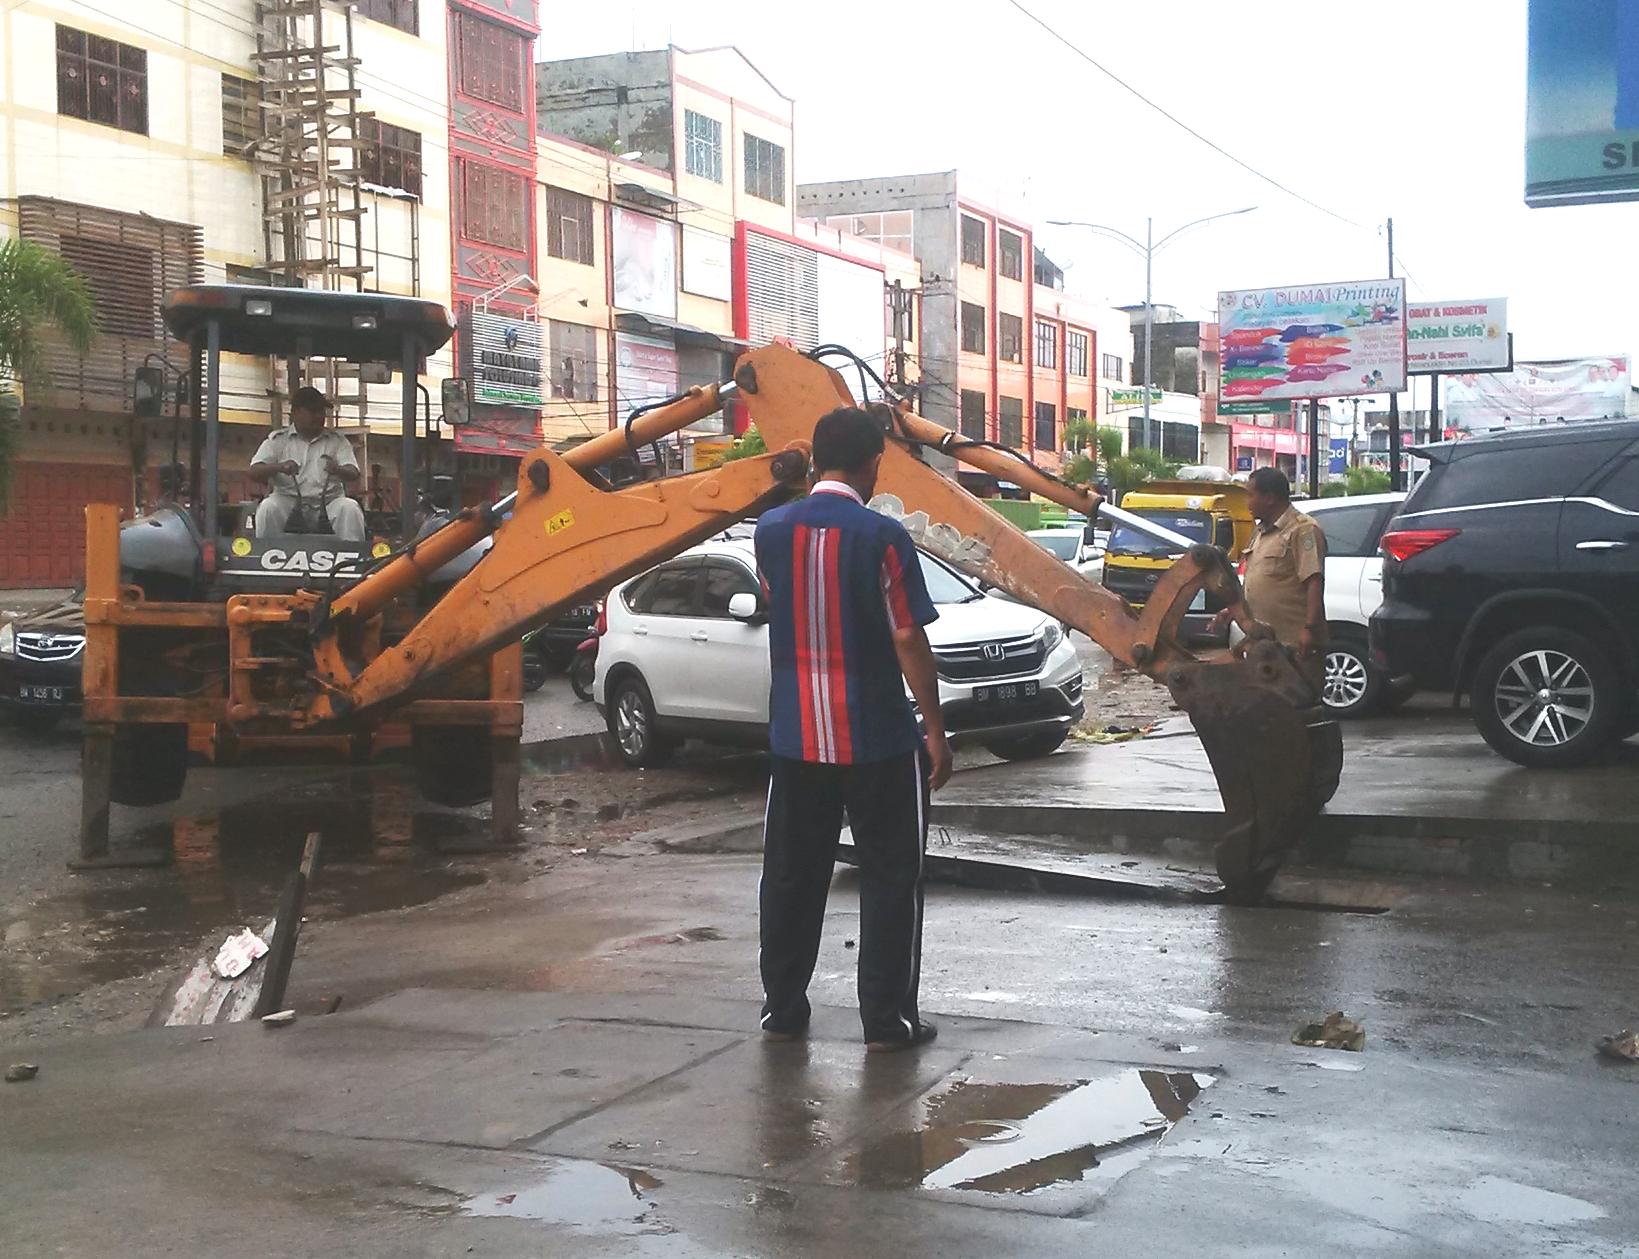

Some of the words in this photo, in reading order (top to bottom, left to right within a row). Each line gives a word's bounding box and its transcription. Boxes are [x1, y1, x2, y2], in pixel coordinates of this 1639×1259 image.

[1242, 292, 1265, 310] CV.
[1275, 287, 1332, 308] DUMAI
[1334, 284, 1400, 301] Printing
[261, 549, 360, 572] CASE
